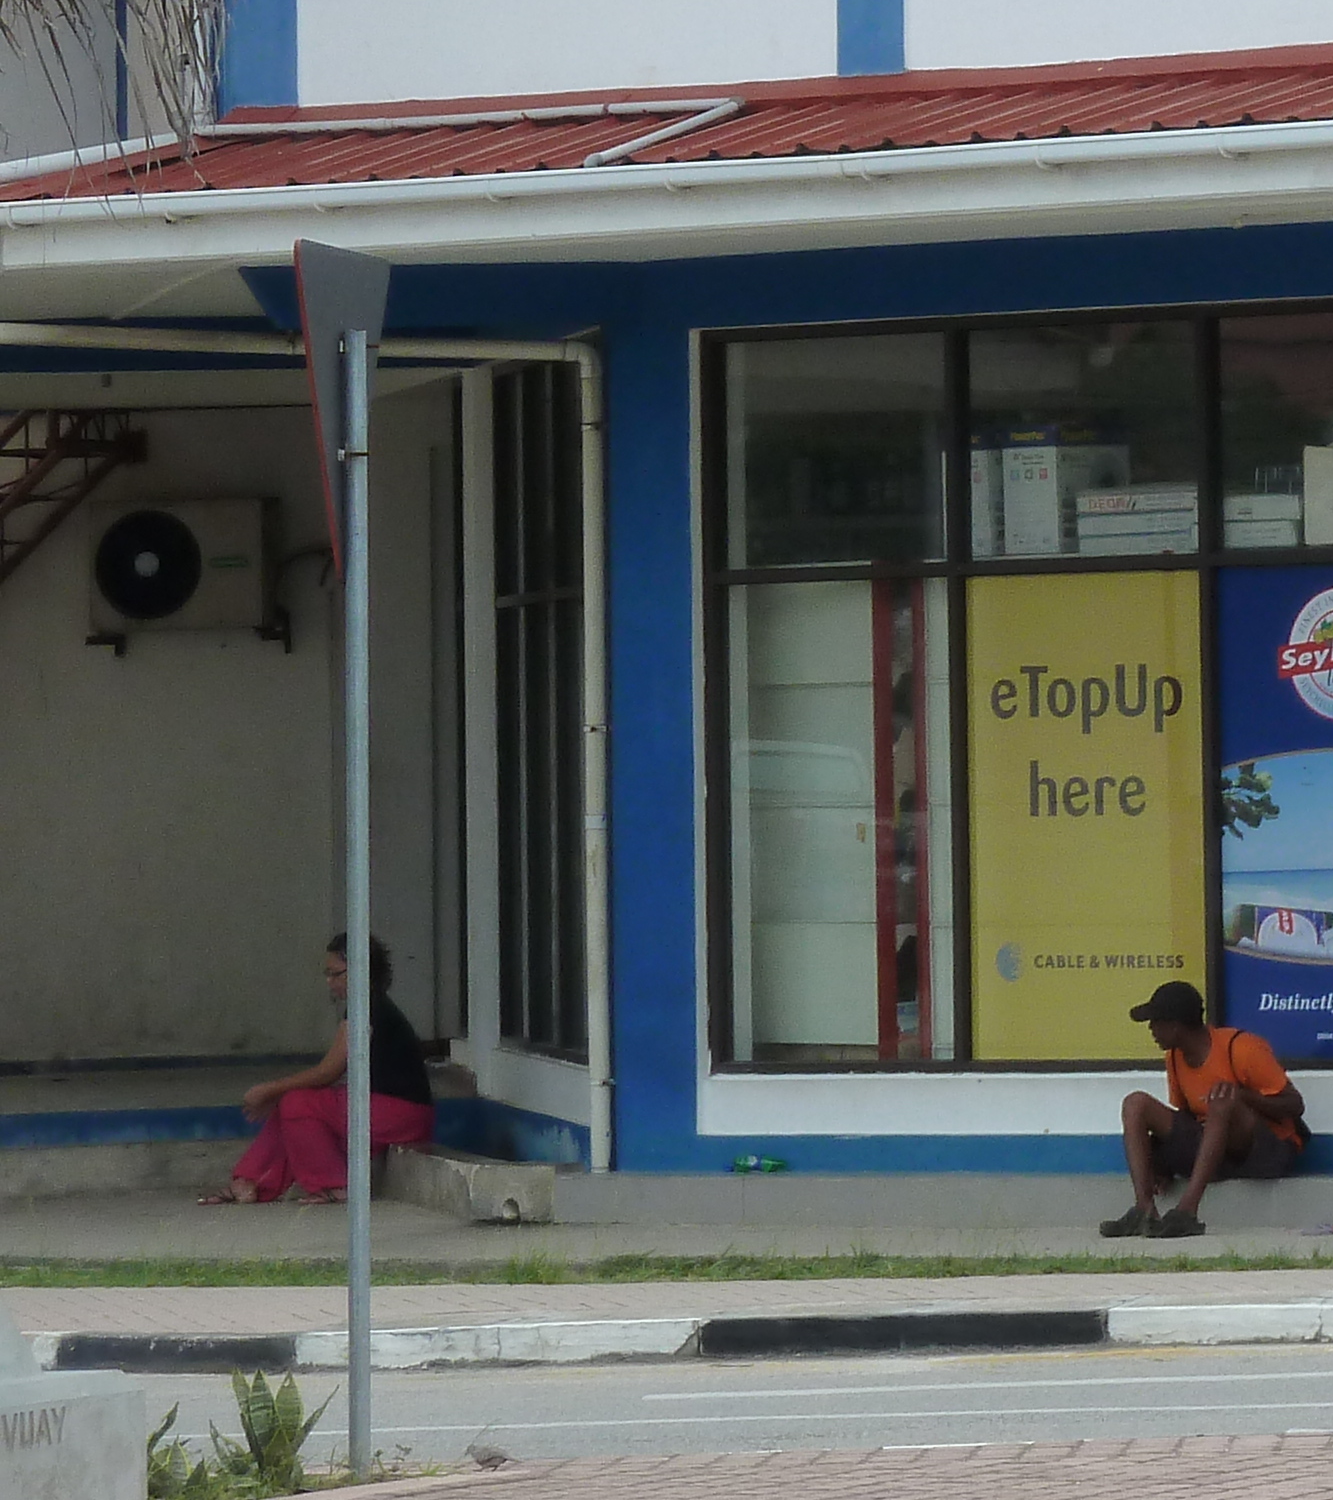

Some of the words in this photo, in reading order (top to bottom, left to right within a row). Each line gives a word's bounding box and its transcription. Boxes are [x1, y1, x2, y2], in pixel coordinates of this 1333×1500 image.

[990, 663, 1183, 735] eTopUp
[1029, 760, 1147, 818] here
[1034, 953, 1087, 970] CABLE
[1089, 954, 1101, 969] &
[1104, 953, 1185, 970] WIRELESS
